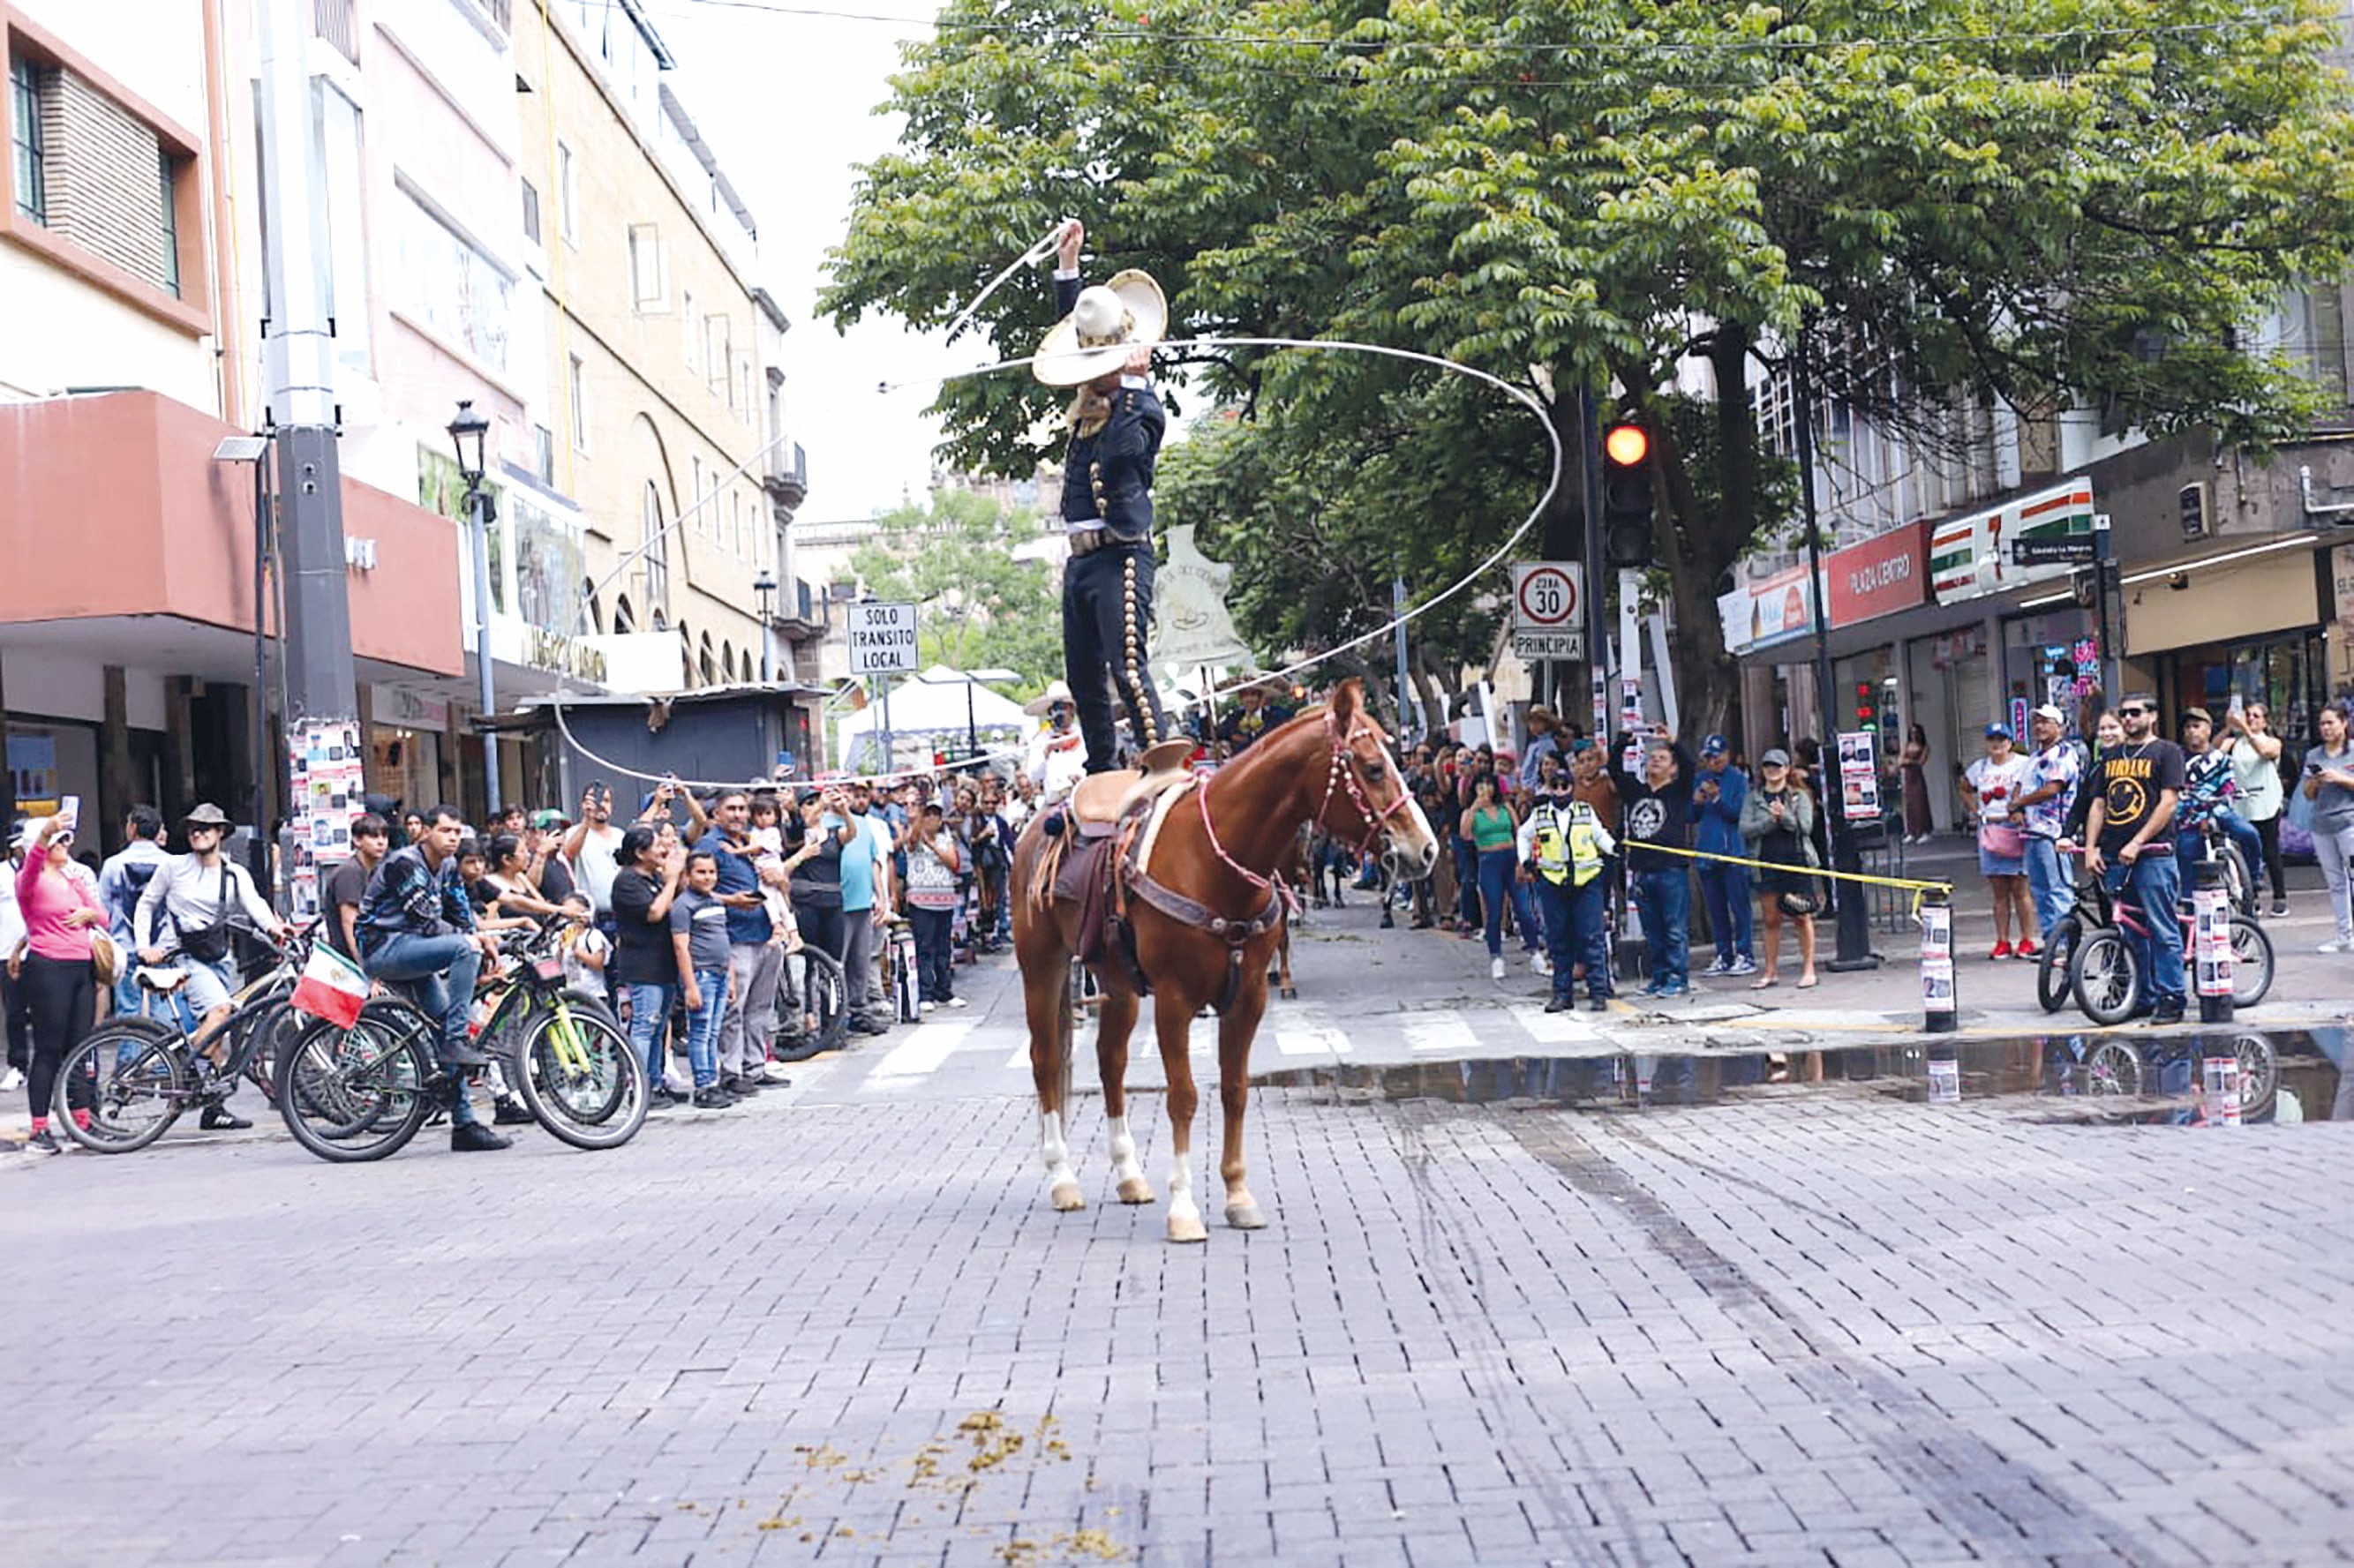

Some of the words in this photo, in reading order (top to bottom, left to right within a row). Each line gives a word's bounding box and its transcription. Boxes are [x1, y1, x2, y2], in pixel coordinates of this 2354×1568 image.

[1536, 589, 1561, 614] 30
[866, 608, 899, 625] SOLO
[853, 629, 914, 647] TRANSITO
[1517, 636, 1578, 654] PRINCIPIA
[863, 651, 903, 668] LOCAL
